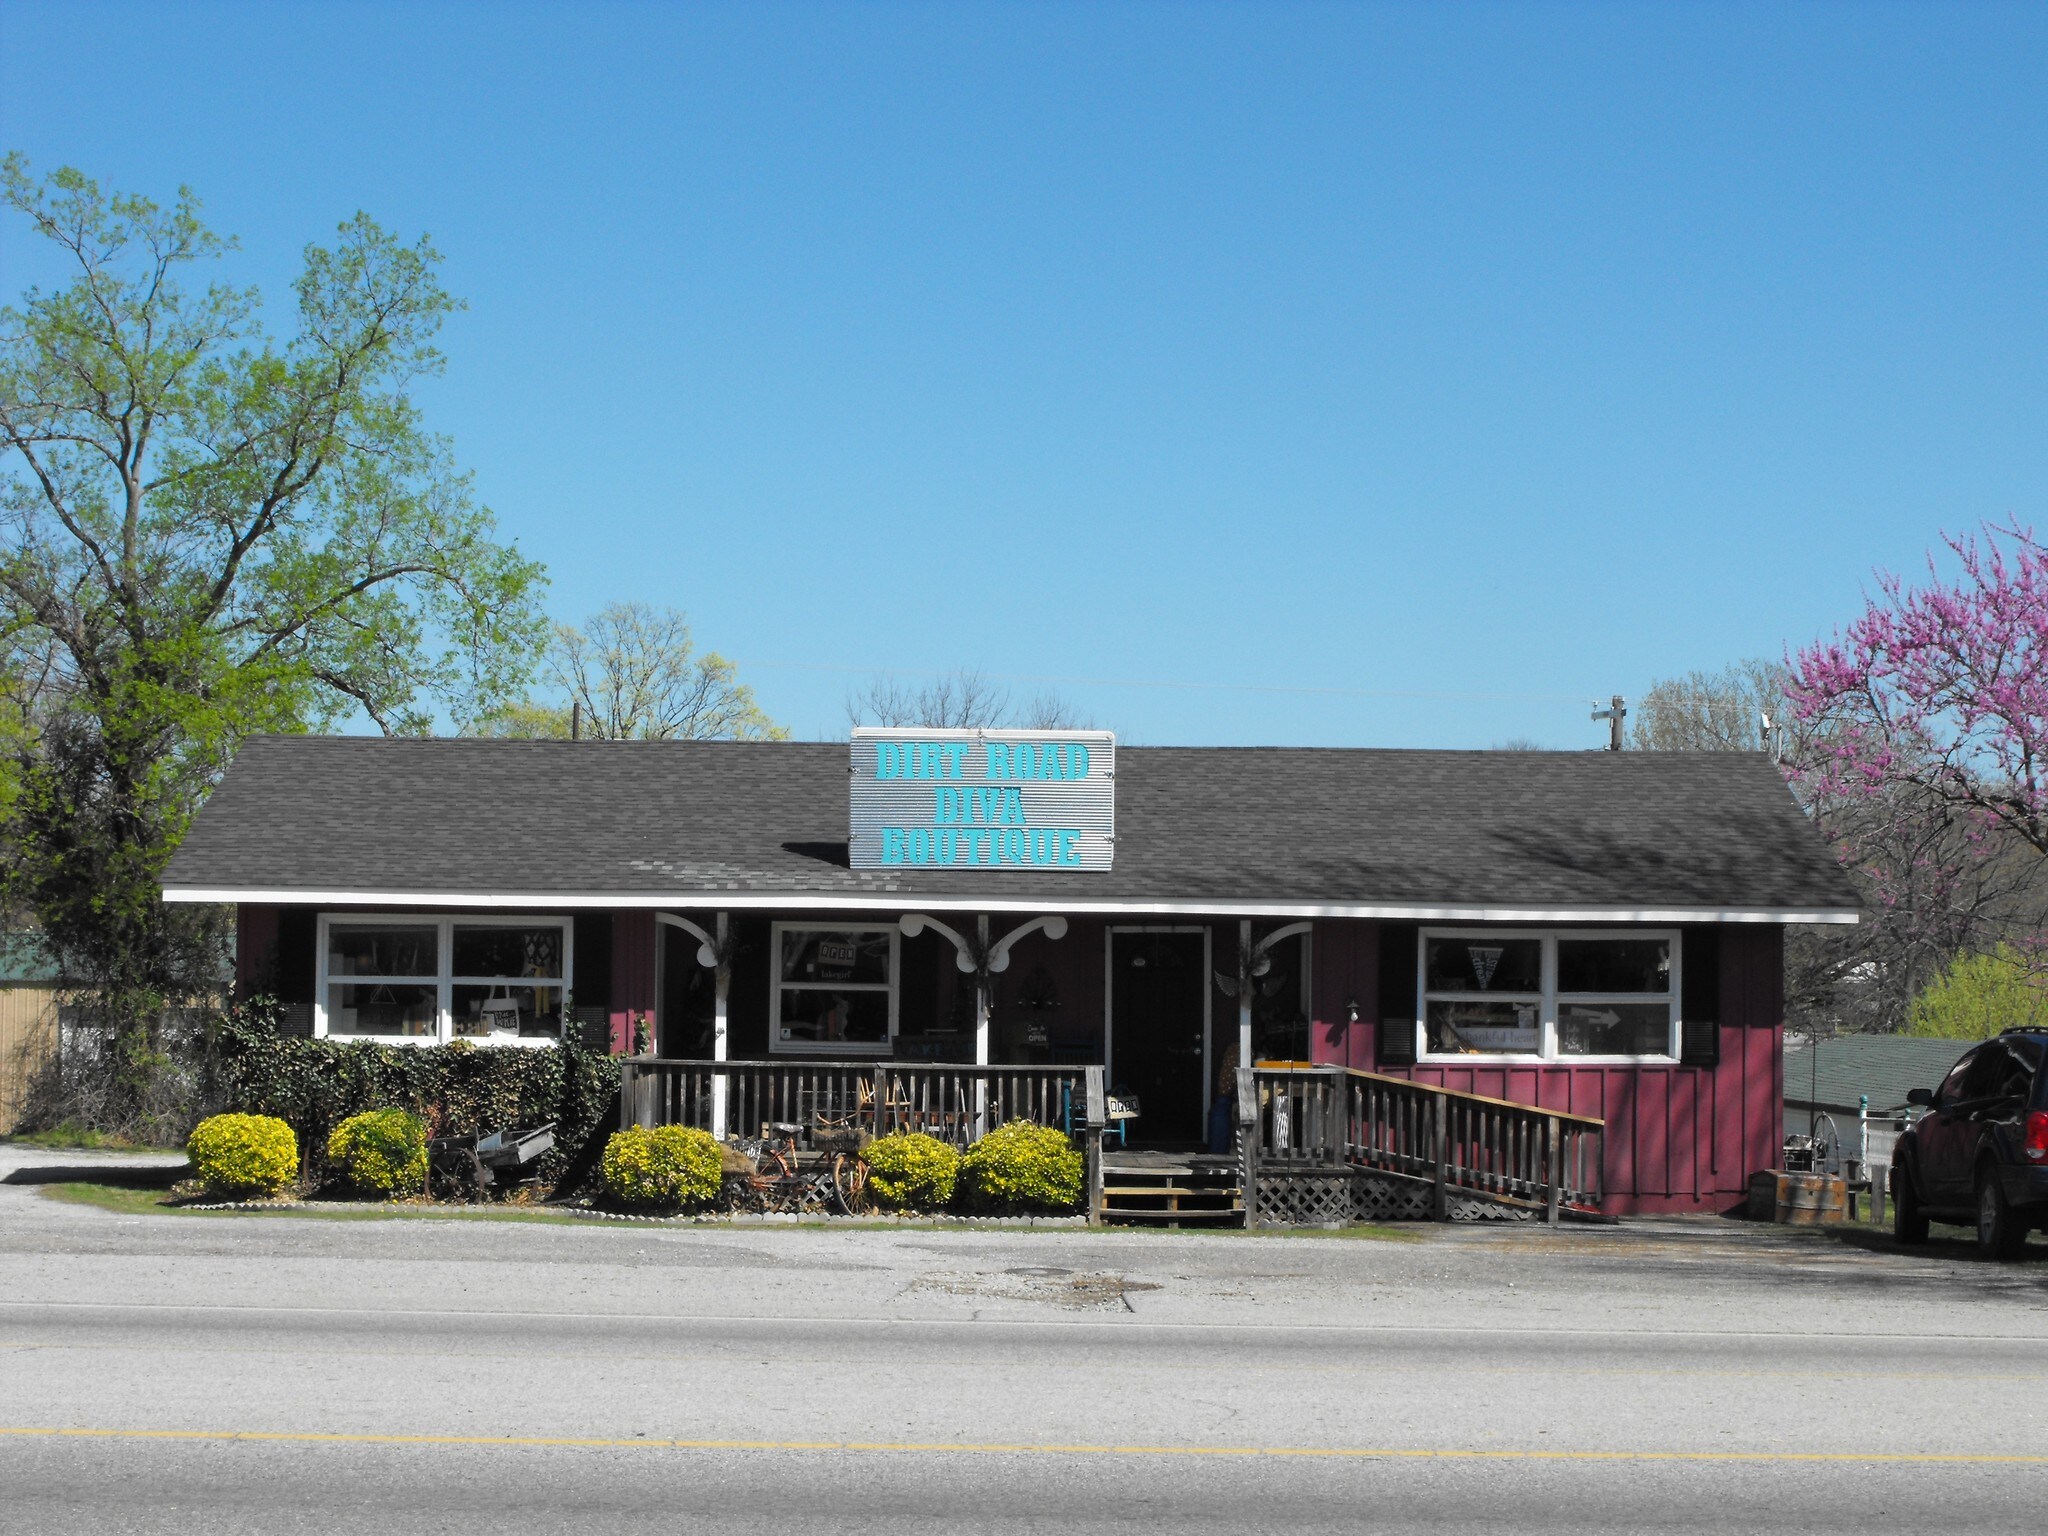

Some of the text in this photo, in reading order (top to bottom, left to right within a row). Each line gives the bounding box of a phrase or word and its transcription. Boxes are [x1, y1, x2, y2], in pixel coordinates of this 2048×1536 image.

[876, 743, 1090, 781] DIRT ROAD
[936, 787, 1026, 825] DIVA
[883, 828, 1081, 865] BOUTIQUE
[821, 945, 853, 959] OPEN
[1028, 1034, 1047, 1042] OPEN
[1110, 1100, 1138, 1112] OPEN
